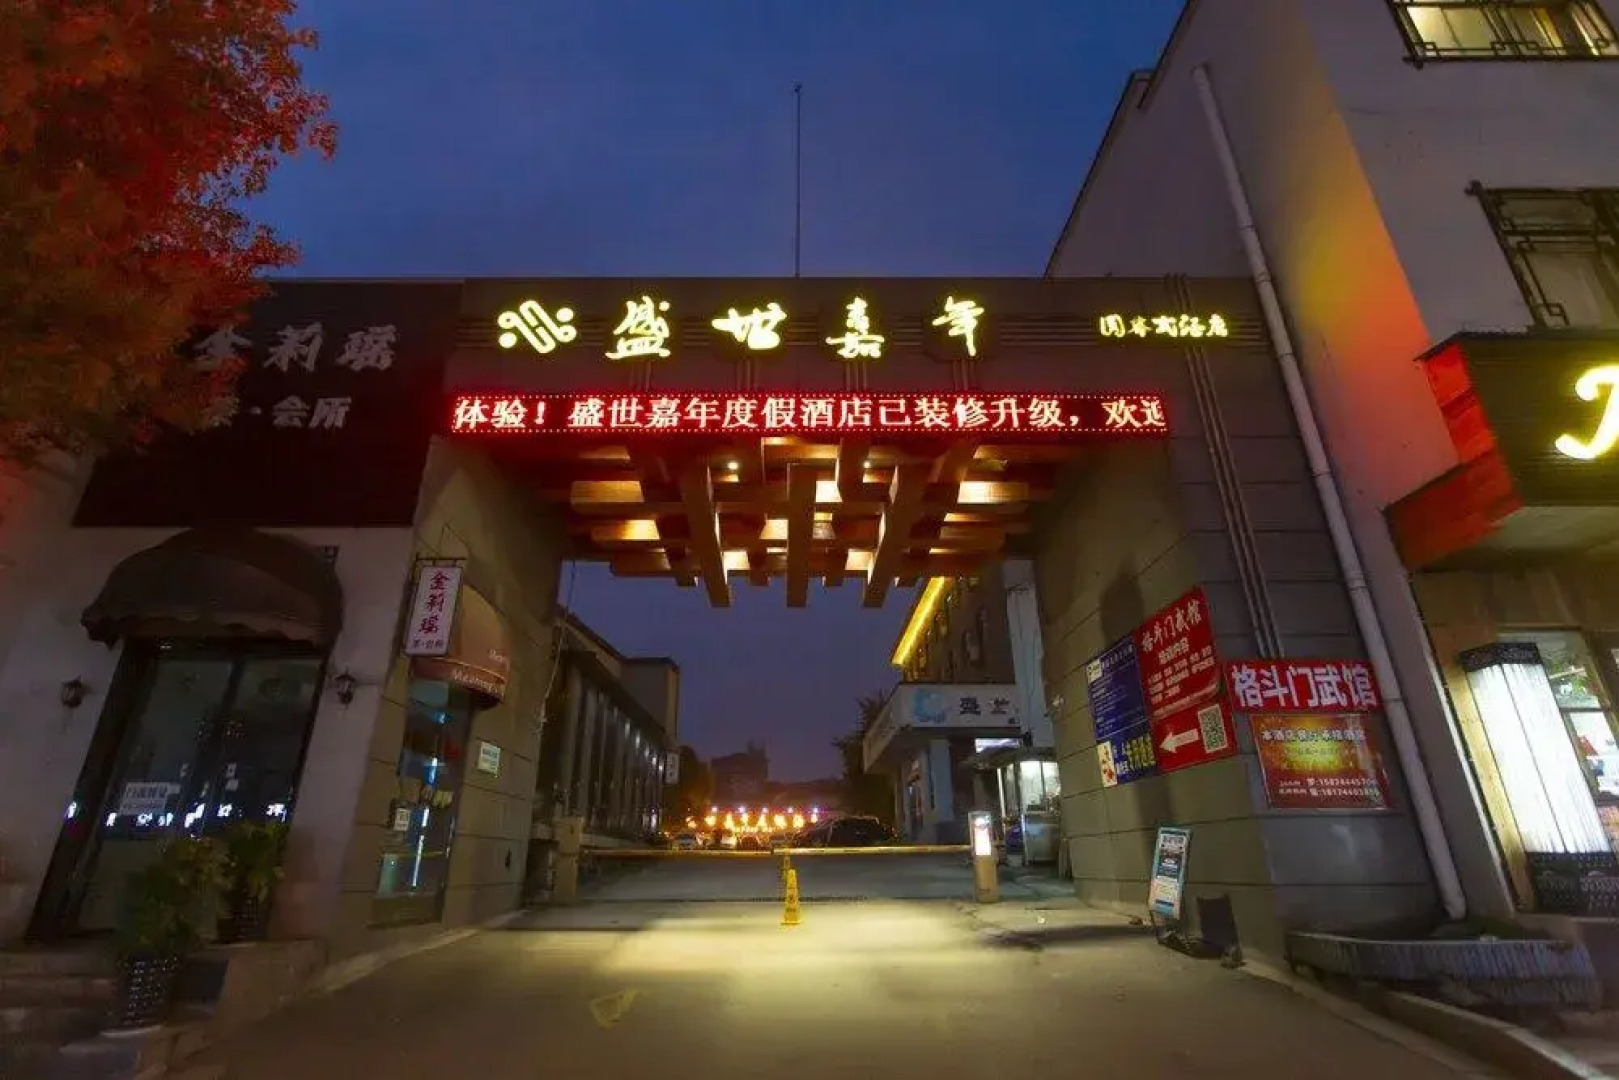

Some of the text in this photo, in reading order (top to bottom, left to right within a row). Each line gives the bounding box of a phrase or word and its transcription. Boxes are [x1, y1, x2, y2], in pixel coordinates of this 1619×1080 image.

[604, 295, 985, 360] 盛世嘉年
[1231, 663, 1377, 707] 格斗门武馆
